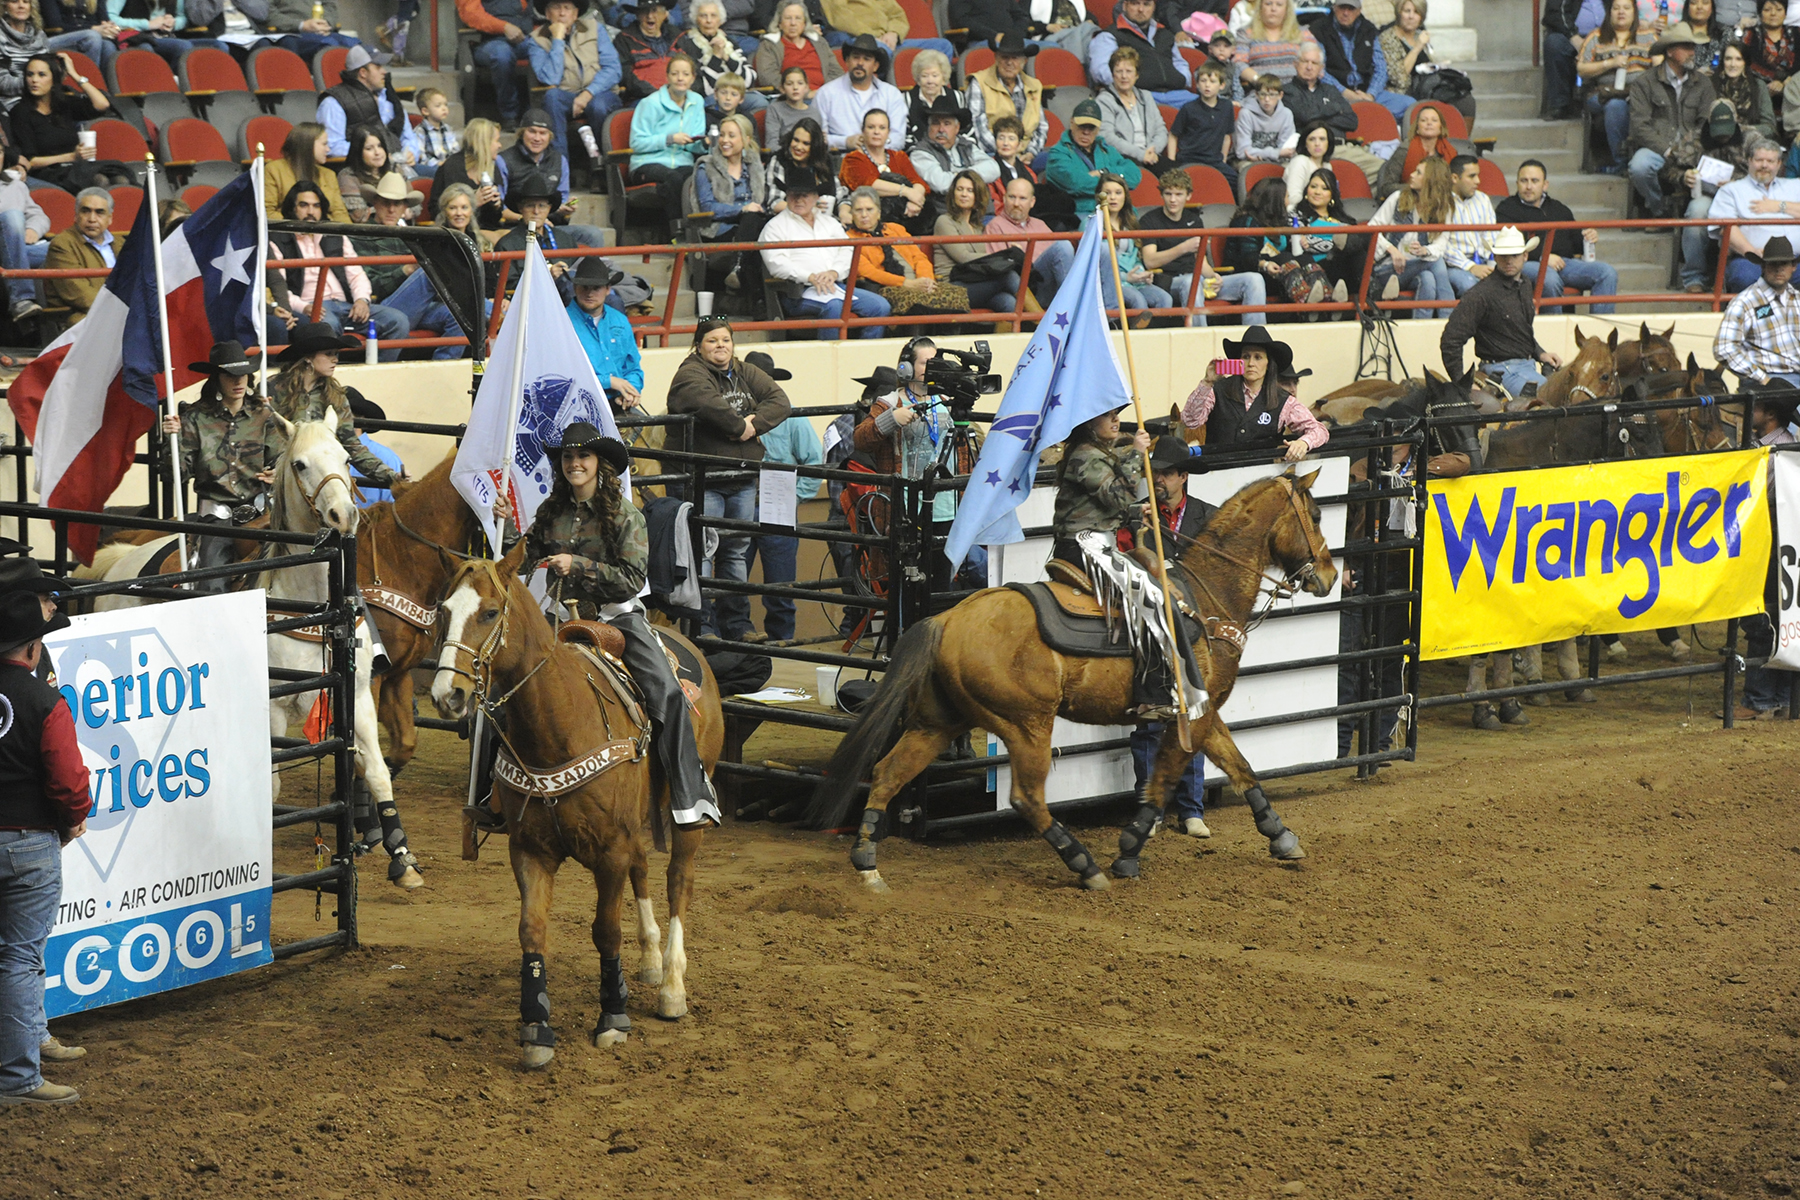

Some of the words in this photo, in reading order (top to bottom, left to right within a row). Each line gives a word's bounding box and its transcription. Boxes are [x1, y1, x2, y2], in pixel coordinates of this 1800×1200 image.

[472, 474, 489, 504] 1775
[1432, 471, 1752, 619] Wrangler
[119, 886, 147, 912] AIR
[151, 861, 260, 904] CONDITIONING
